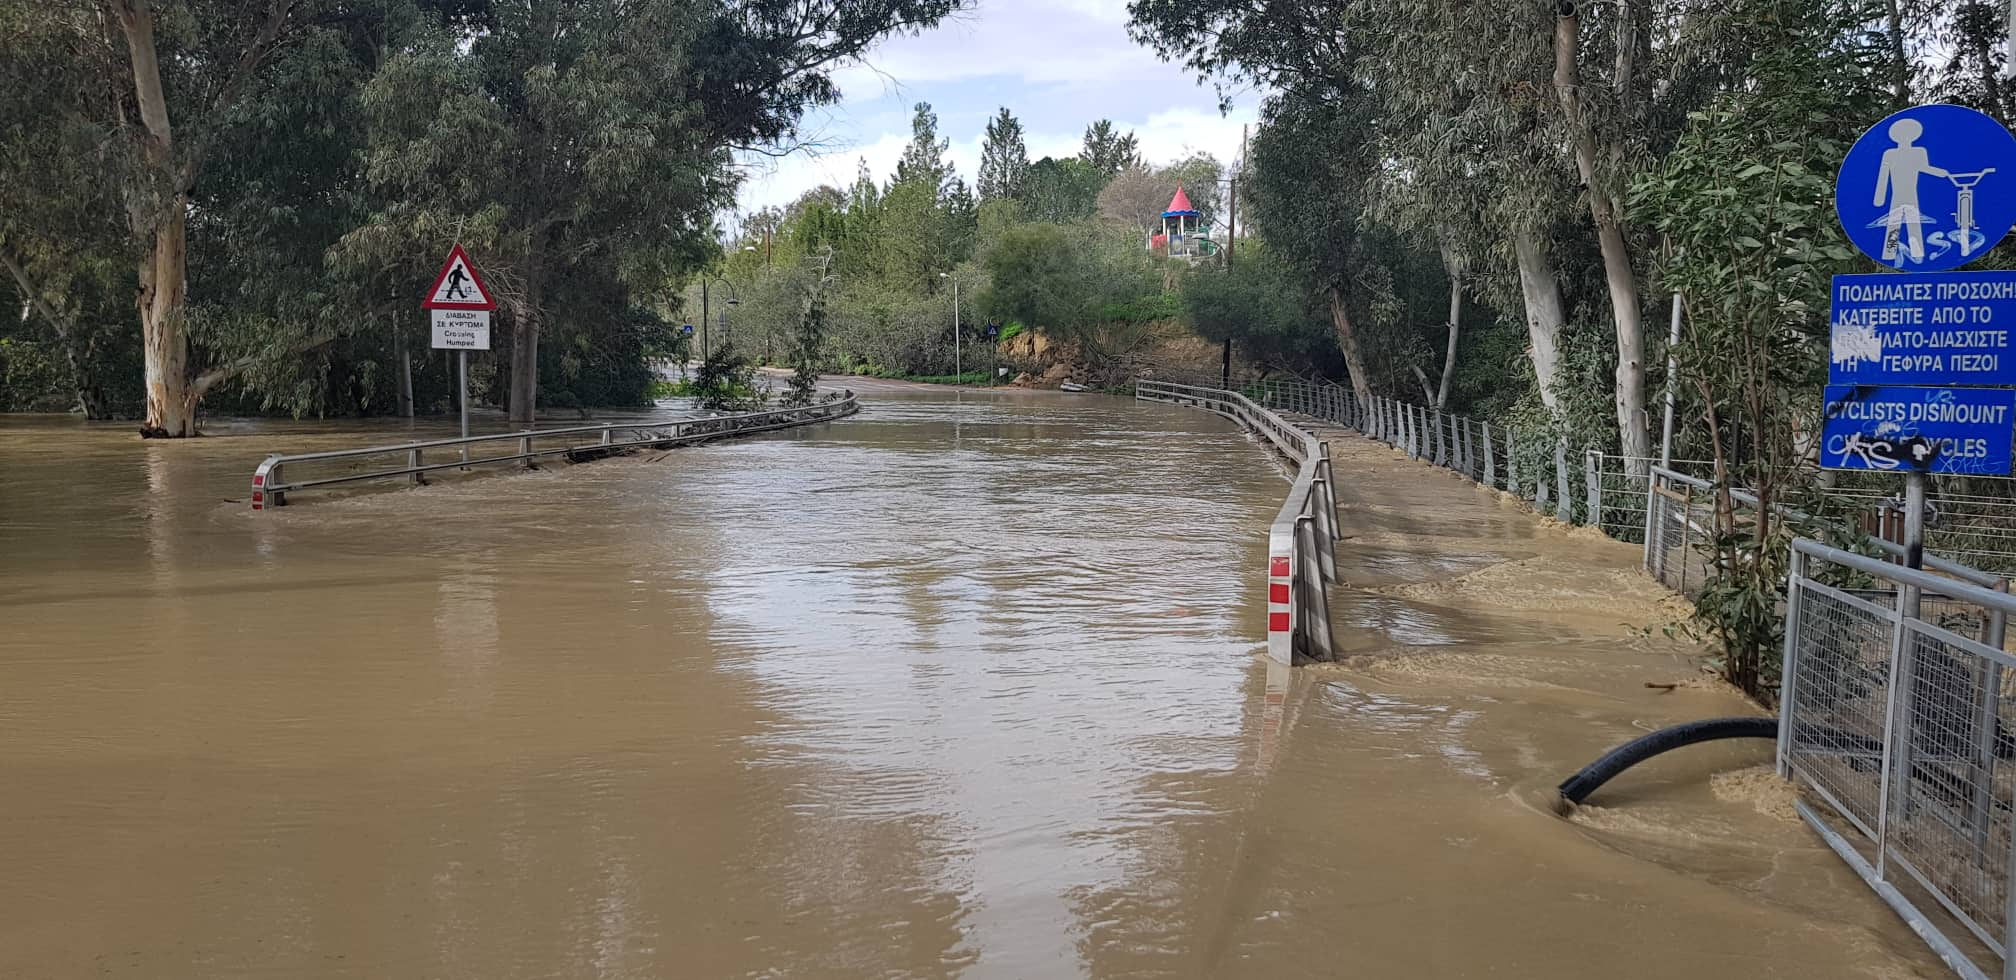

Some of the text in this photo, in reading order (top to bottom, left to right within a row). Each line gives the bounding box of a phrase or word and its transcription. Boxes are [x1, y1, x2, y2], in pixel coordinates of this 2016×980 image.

[1839, 284, 1932, 302] ΠΟΔΗΛΑΤΕΣ
[1839, 306, 1992, 325] ΚΑΤΕΒΕΙΤΕ ΑΠΟ ΤΟ
[1882, 354, 1943, 372] ΓΕΦΥΡΑ
[1951, 354, 1998, 372] ΠΕΖΟΙ
[1826, 401, 2007, 424] CYCLISTS DISMOUNT
